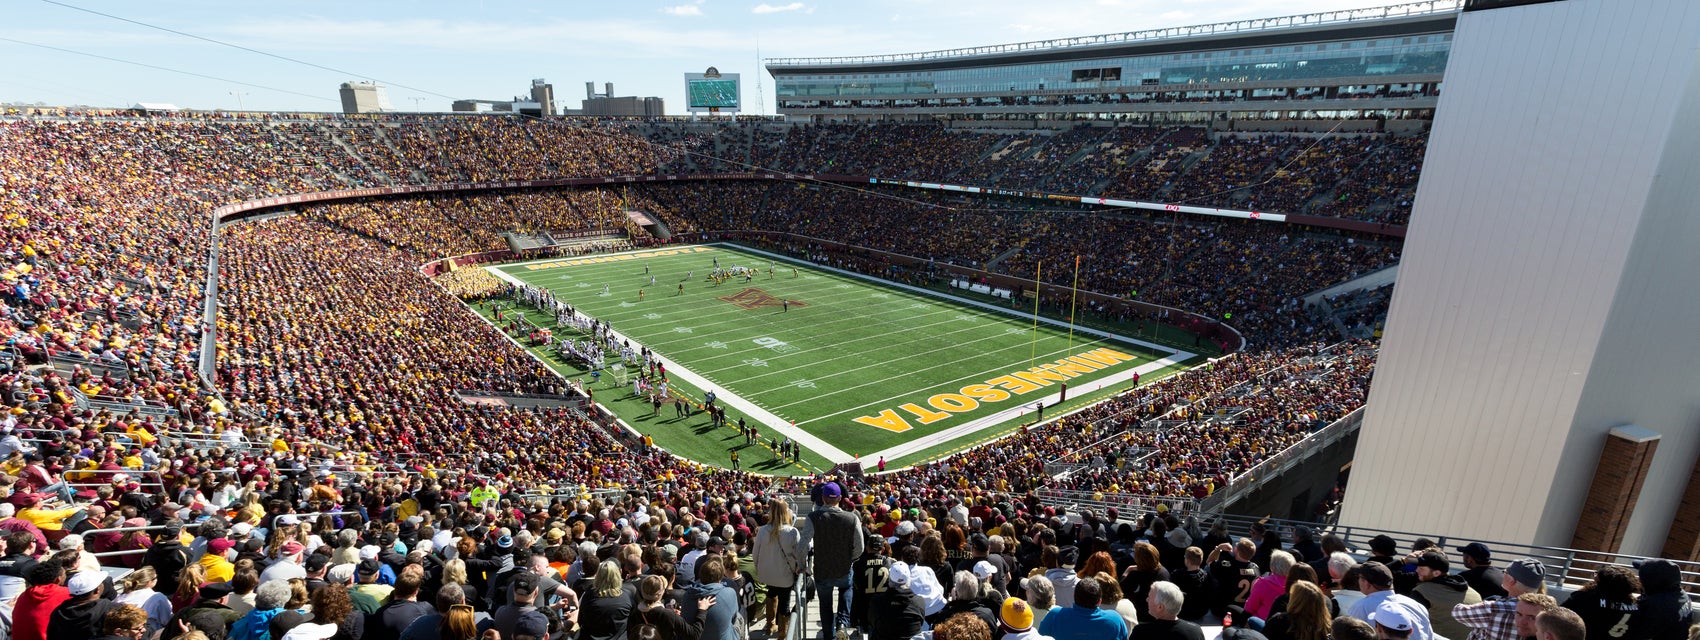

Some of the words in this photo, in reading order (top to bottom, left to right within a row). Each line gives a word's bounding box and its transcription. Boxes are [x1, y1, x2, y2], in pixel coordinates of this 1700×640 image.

[335, 189, 385, 197] CHAMPIONSHIPS
[525, 247, 716, 271] MINNESOTA
[852, 347, 1139, 433] MINNESOTA
[865, 567, 889, 594] 12
[1608, 613, 1631, 638] 6
